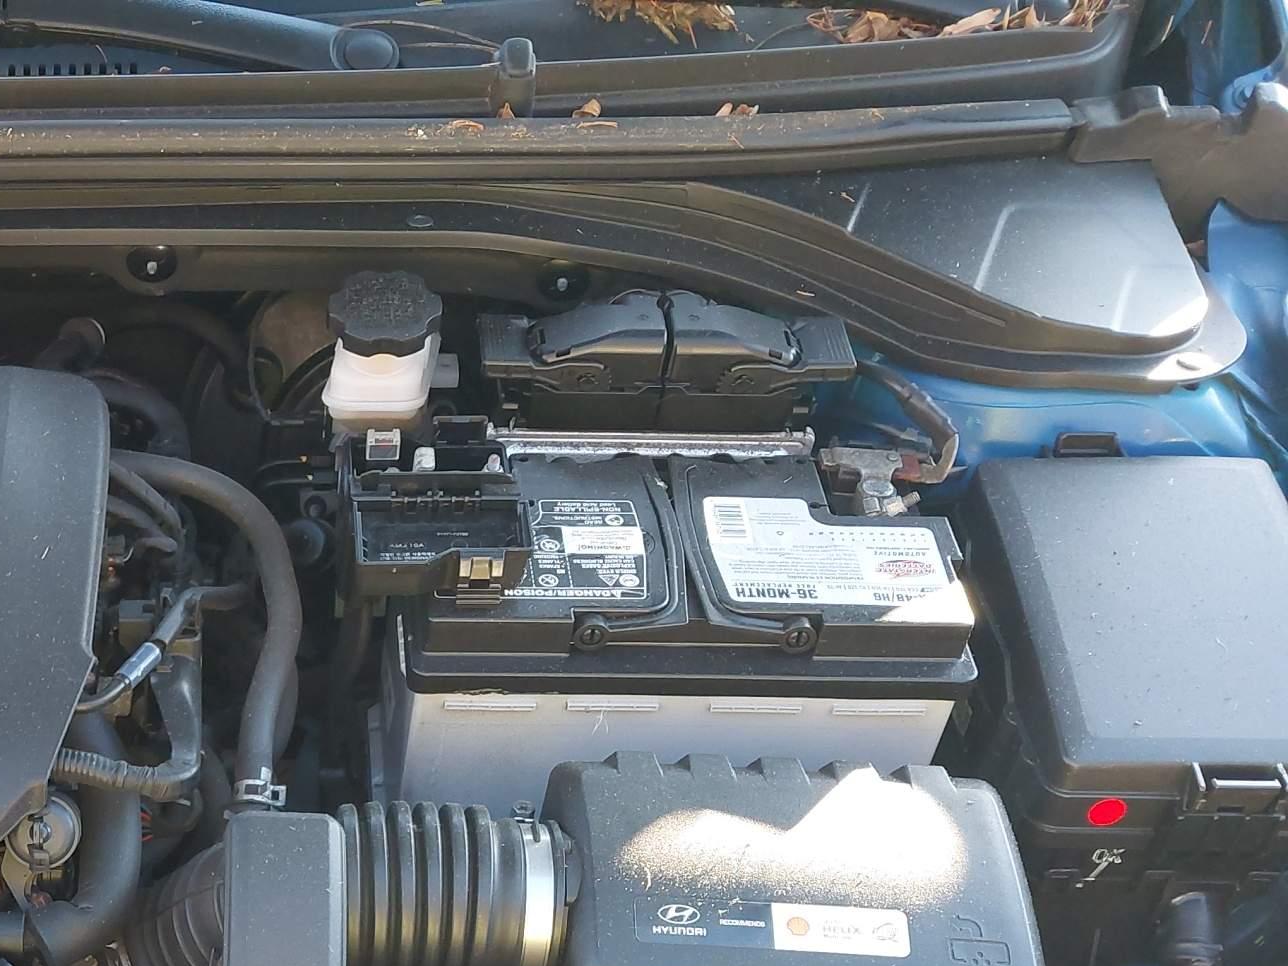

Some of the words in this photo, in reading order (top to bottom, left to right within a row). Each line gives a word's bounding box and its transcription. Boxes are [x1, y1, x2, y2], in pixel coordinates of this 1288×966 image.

[875, 567, 935, 575] INTERSTATE
[504, 589, 612, 597] DANGER/POISON
[735, 587, 819, 600] 36-MONTH
[652, 925, 707, 937] HYUNDAI
[719, 918, 766, 928] RECOMMENDS
